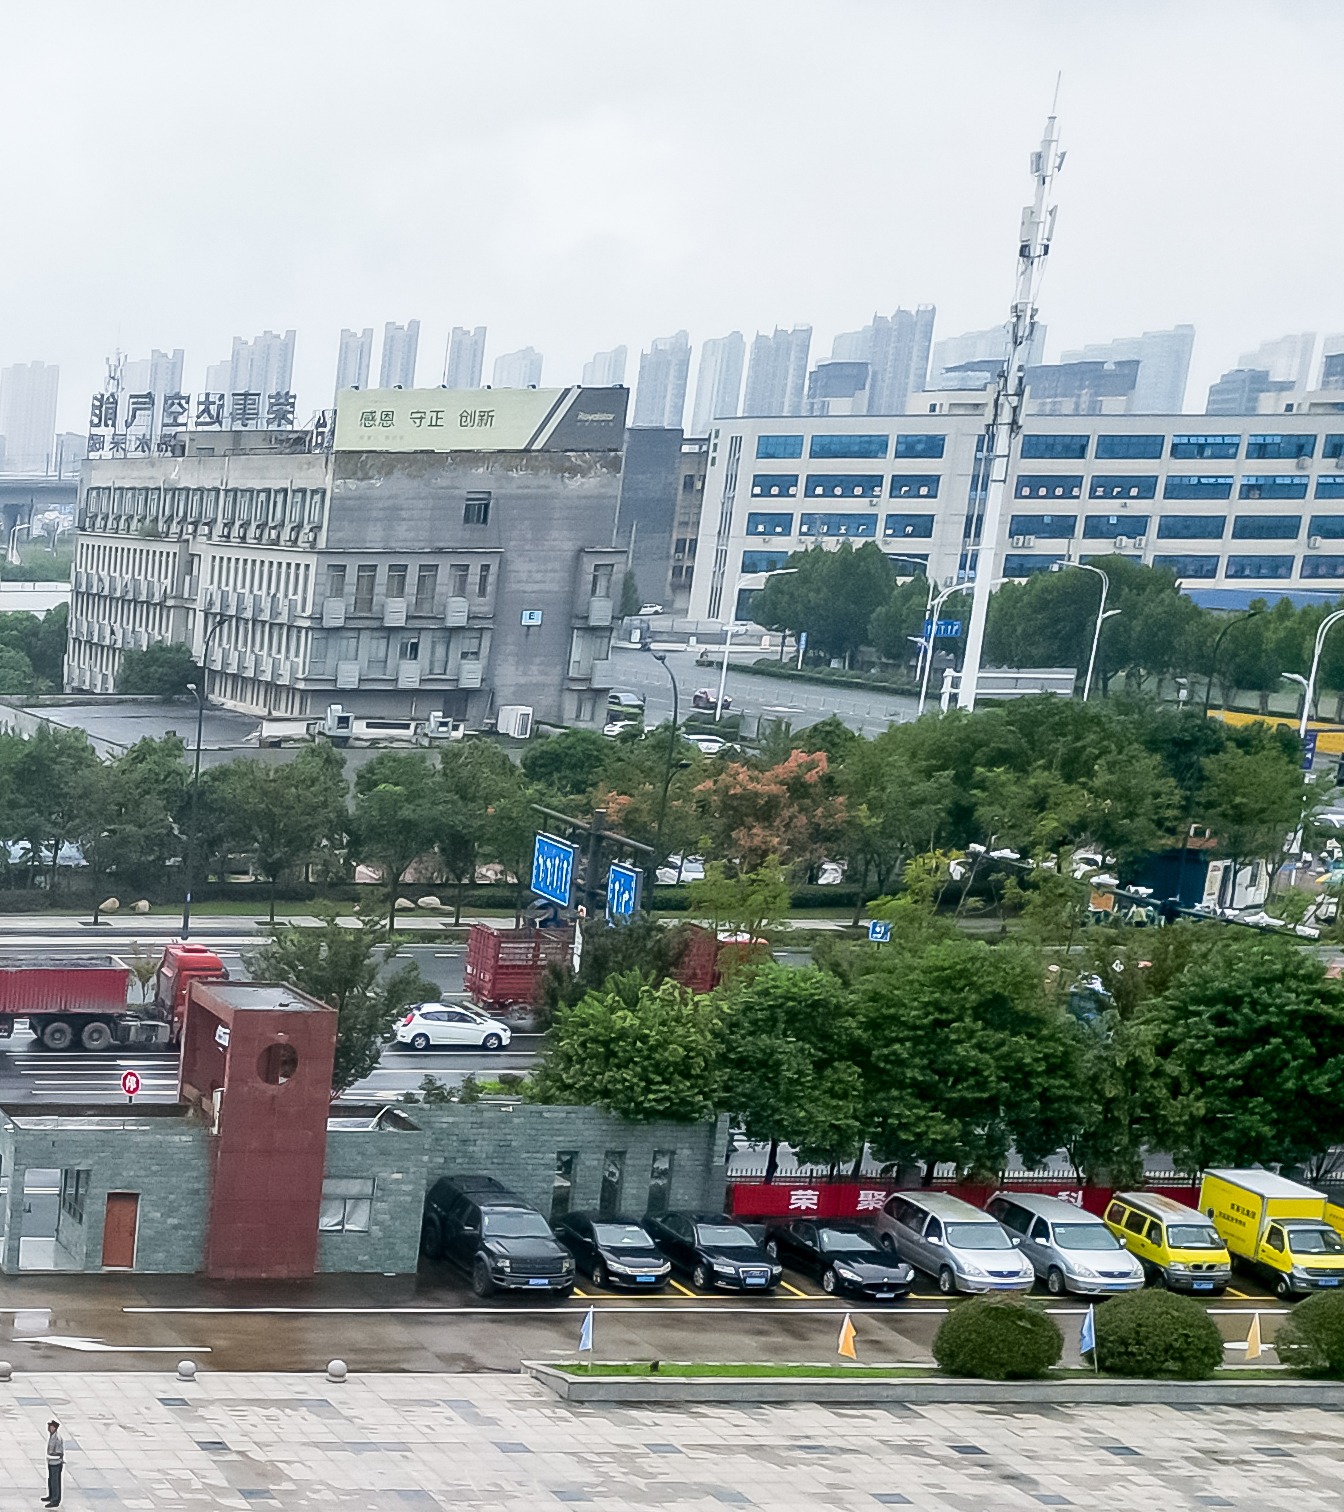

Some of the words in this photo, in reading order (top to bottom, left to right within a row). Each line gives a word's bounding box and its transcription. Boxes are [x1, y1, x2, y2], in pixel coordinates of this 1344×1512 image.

[359, 409, 395, 428] 感恩
[409, 410, 445, 428] 守正
[458, 409, 495, 428] 创新
